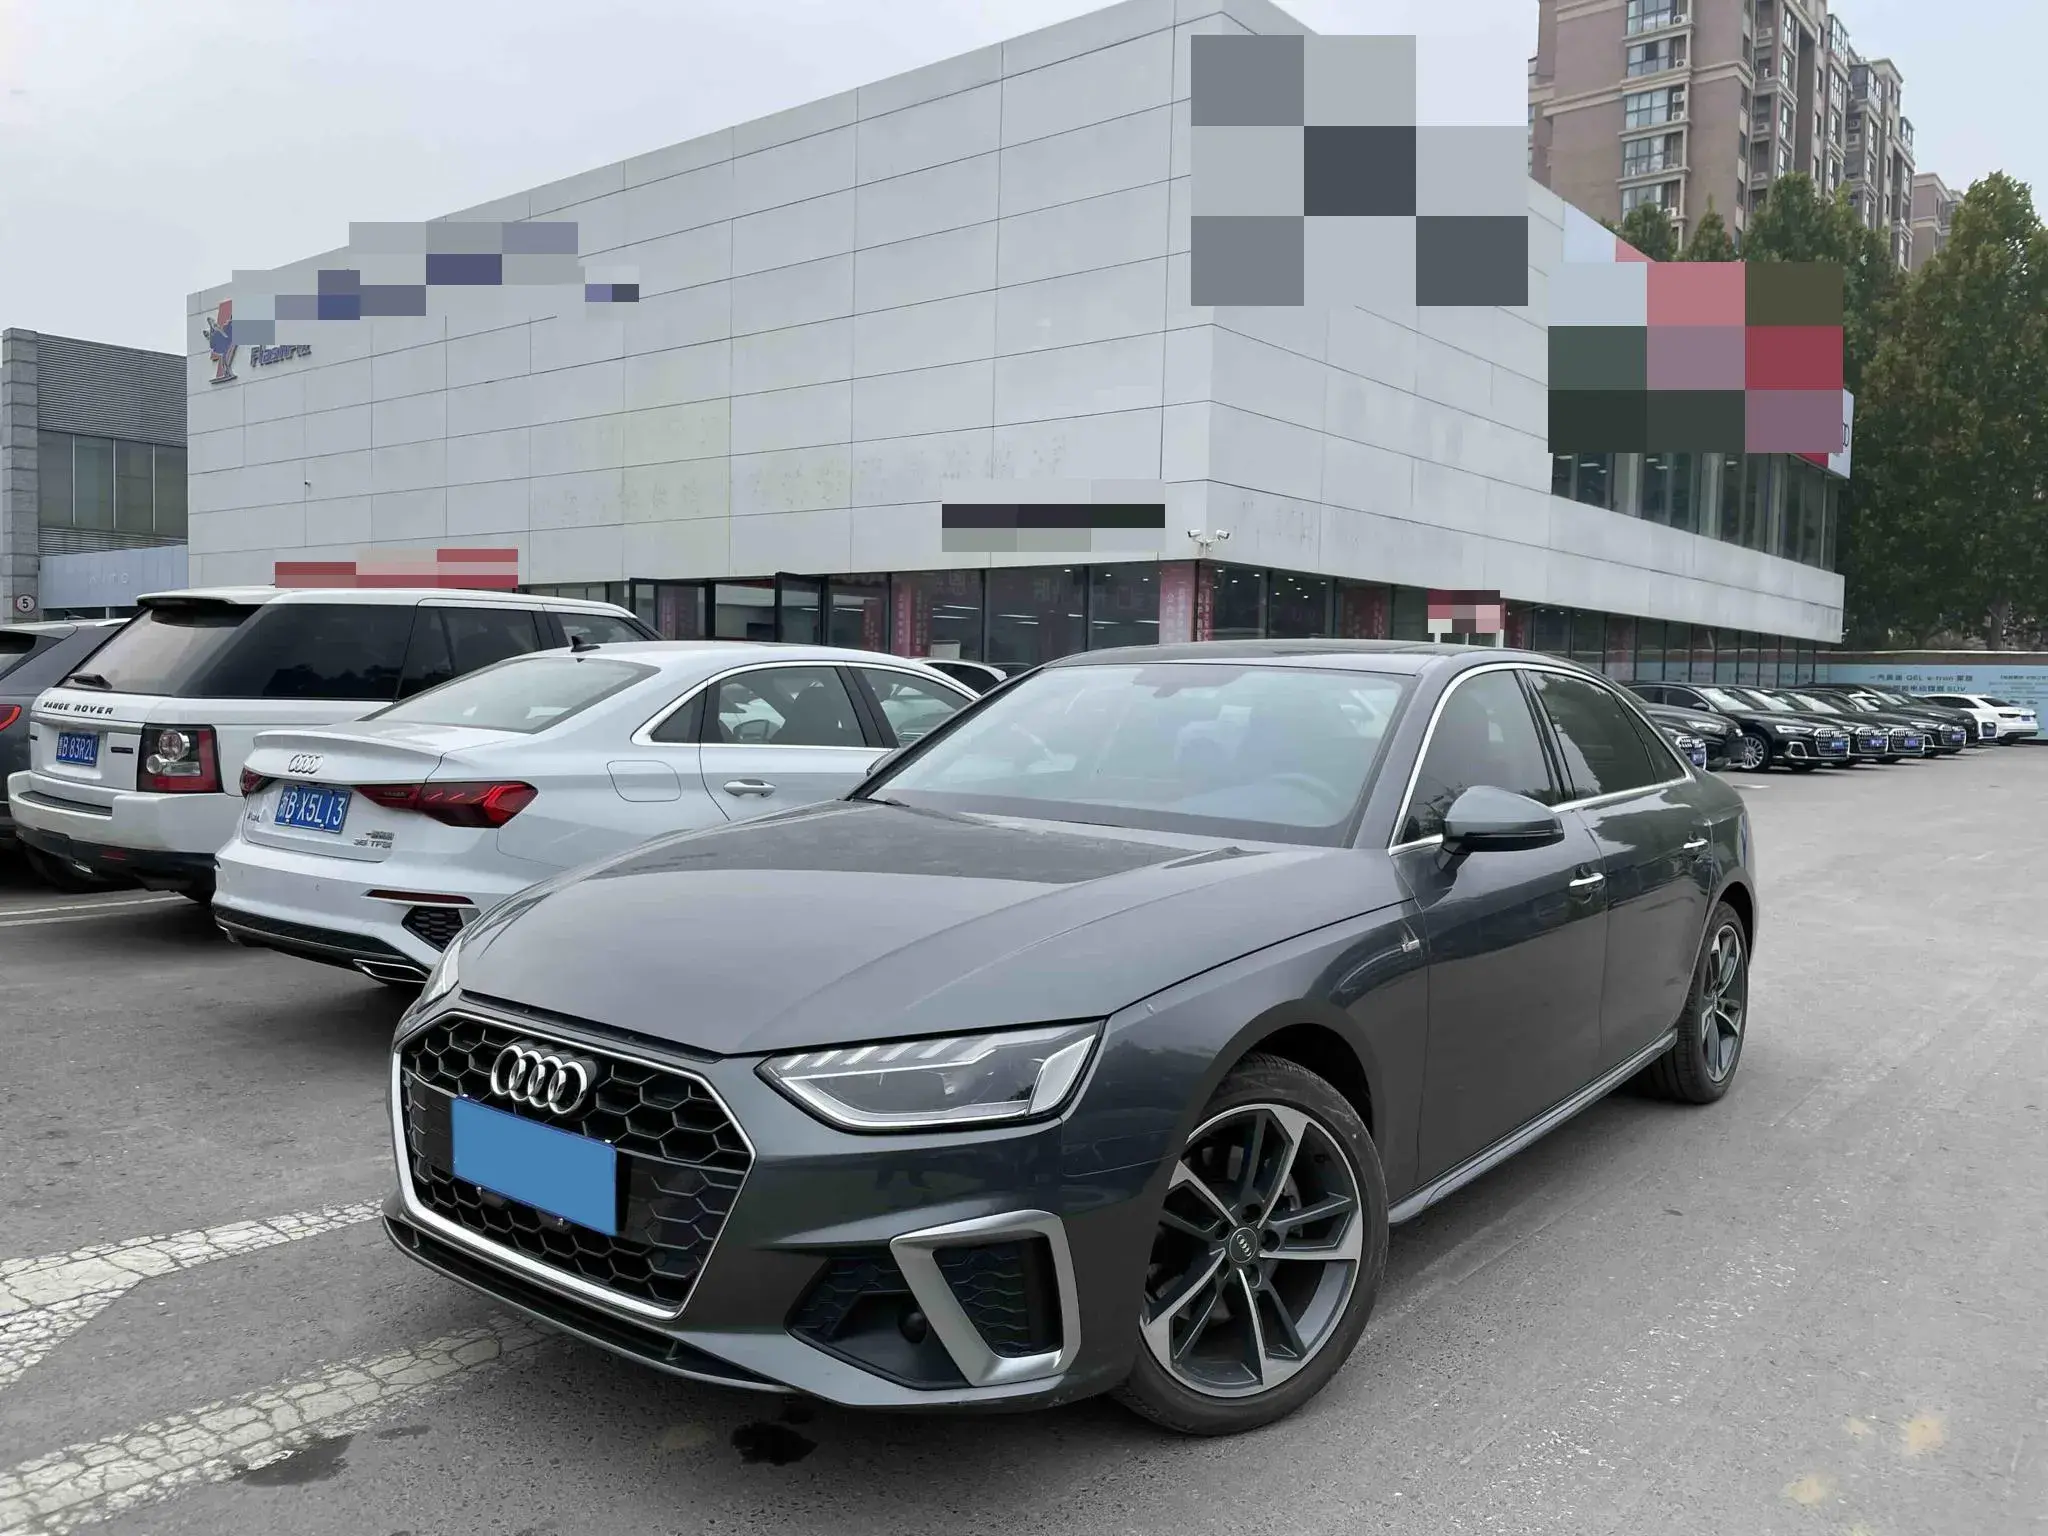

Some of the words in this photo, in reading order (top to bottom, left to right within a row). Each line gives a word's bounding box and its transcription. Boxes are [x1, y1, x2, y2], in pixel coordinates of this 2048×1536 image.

[22, 598, 29, 609] 5
[43, 701, 69, 711] RANGE
[74, 704, 114, 715] ROVER
